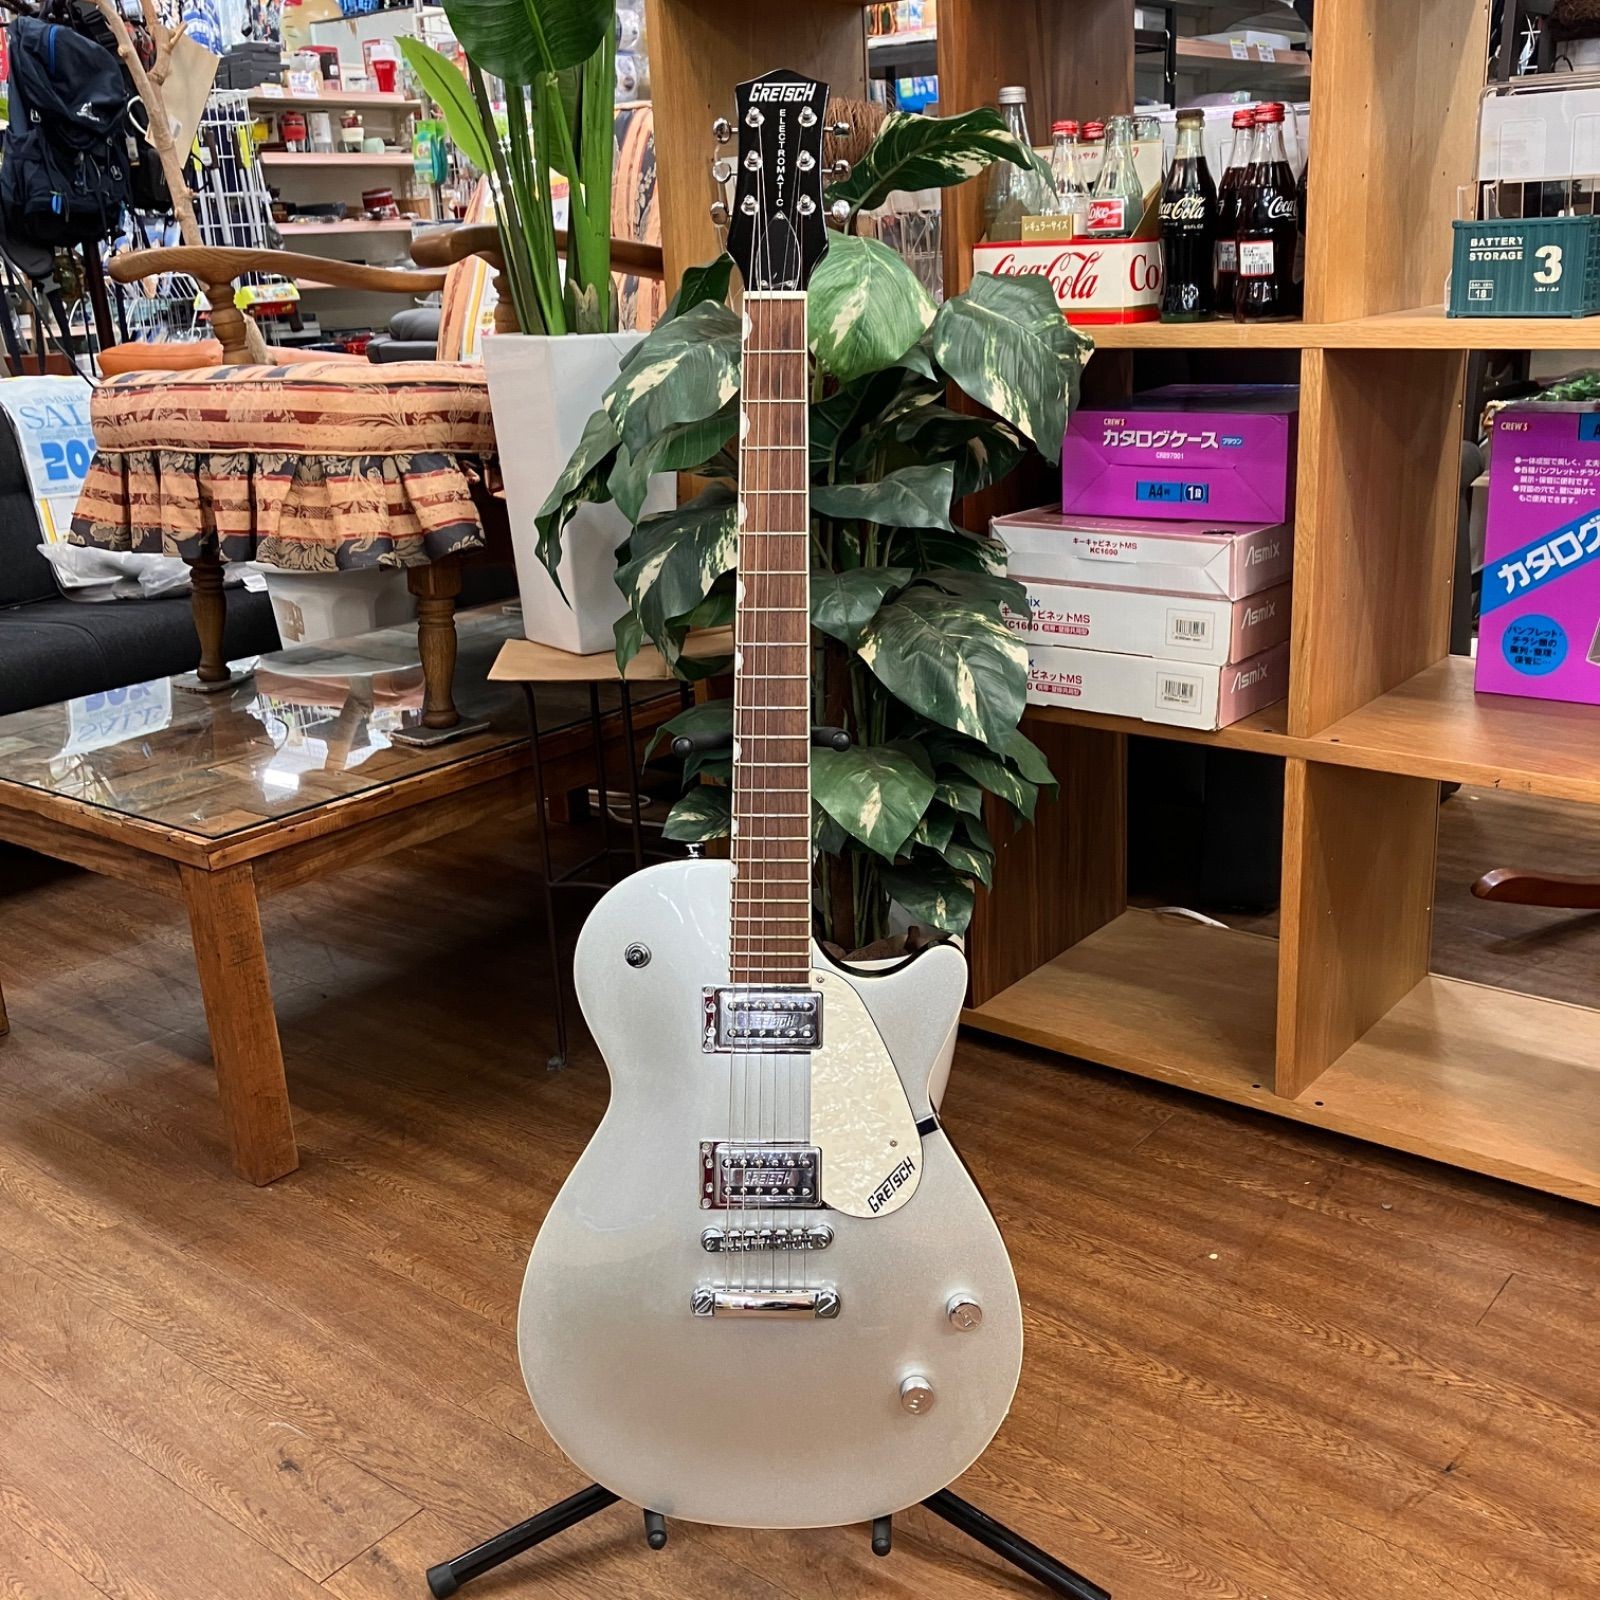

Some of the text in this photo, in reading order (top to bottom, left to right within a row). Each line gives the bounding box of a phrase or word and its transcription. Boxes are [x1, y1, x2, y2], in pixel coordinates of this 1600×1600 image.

[749, 83, 817, 102] GRETSCH
[776, 109, 787, 207] ELECTROMATIC
[1470, 237, 1524, 247] BATTERY
[1469, 251, 1523, 261] STORAGE
[1533, 245, 1563, 284] 3
[1475, 289, 1487, 298] 18
[19, 403, 91, 430] SAL
[1103, 430, 1219, 448] カタログケース
[40, 438, 97, 480] 20
[1089, 547, 1119, 556] KC1600
[1245, 540, 1280, 567] Asmix
[1241, 600, 1276, 630] Asmix
[1231, 662, 1268, 694] Asmix
[867, 1156, 916, 1214] GRETSCH
